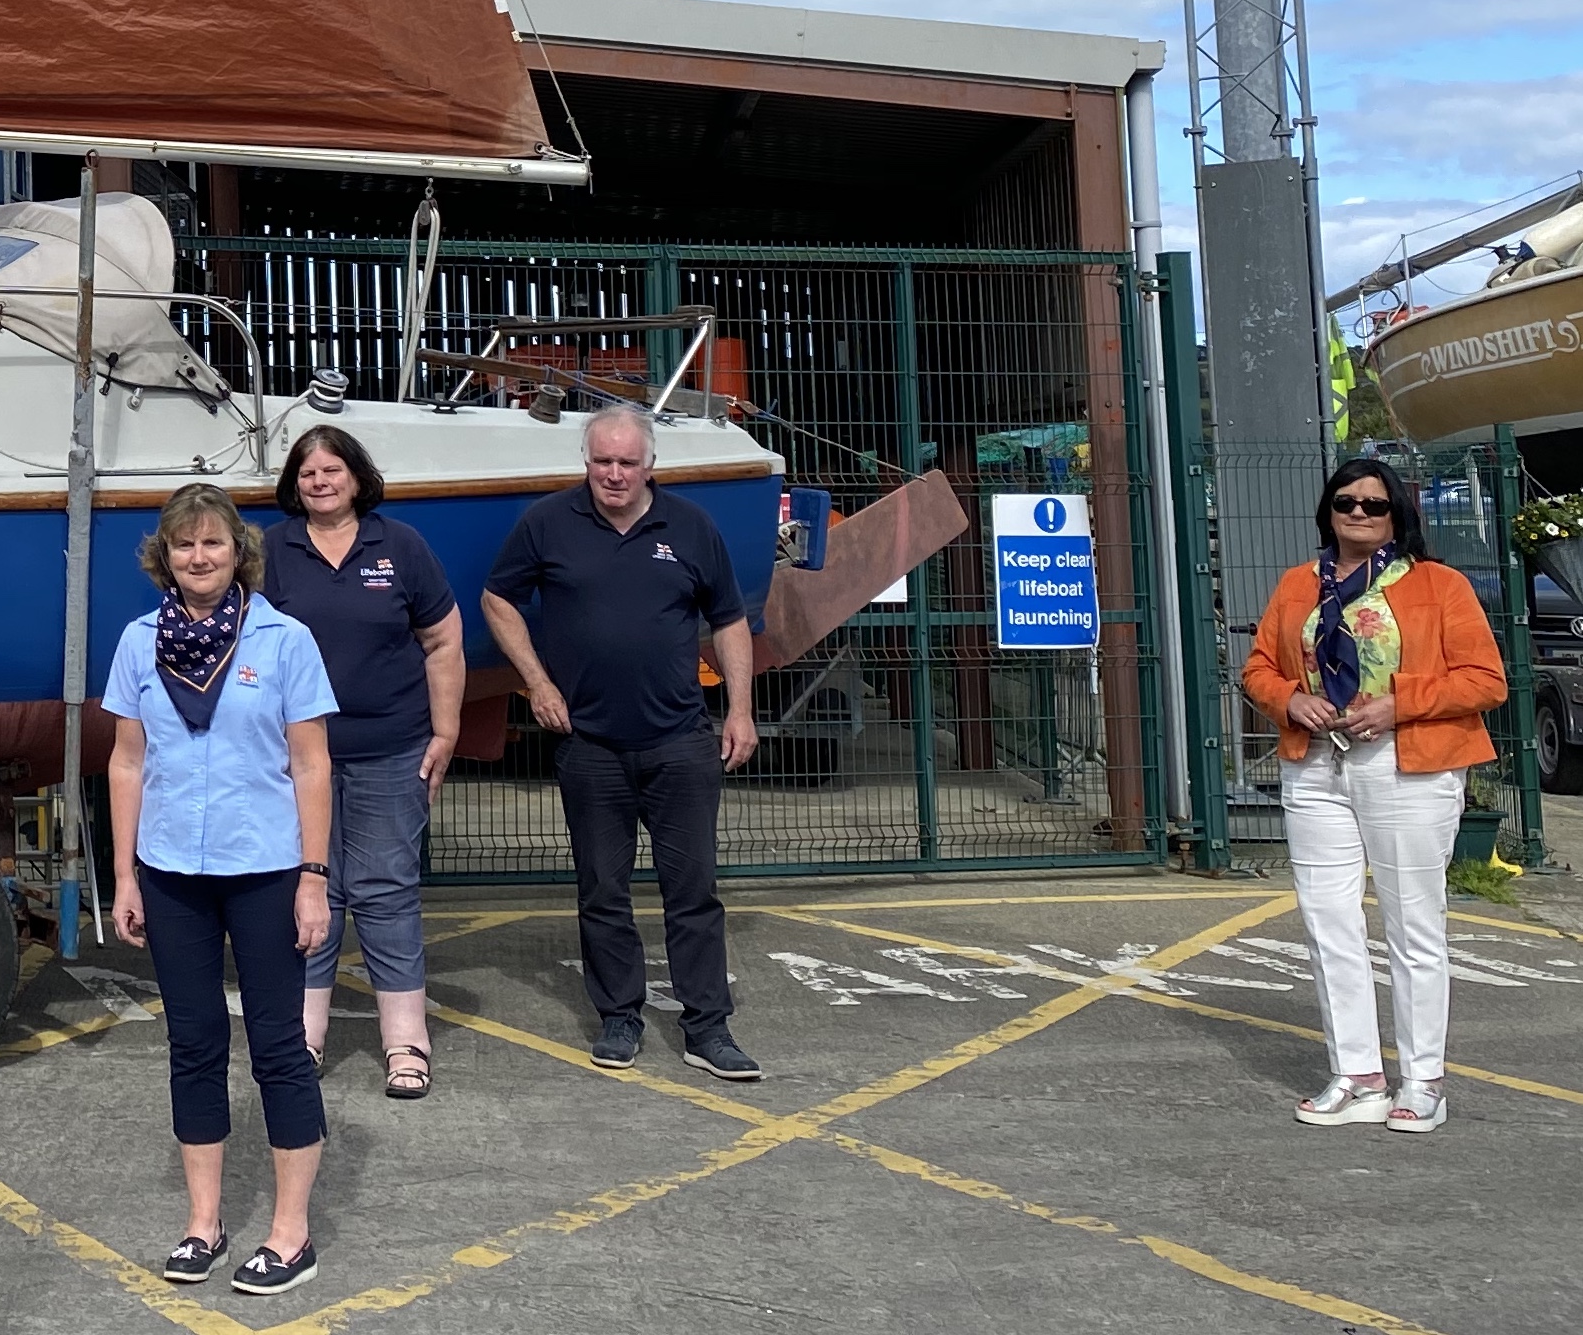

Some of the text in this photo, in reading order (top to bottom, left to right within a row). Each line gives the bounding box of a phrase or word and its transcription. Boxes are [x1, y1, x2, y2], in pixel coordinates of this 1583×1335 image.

[1428, 319, 1557, 374] WINDSHIFT
[1003, 551, 1091, 571] Keep clear
[1019, 580, 1084, 597] lifeboat
[1009, 609, 1092, 629] launching
